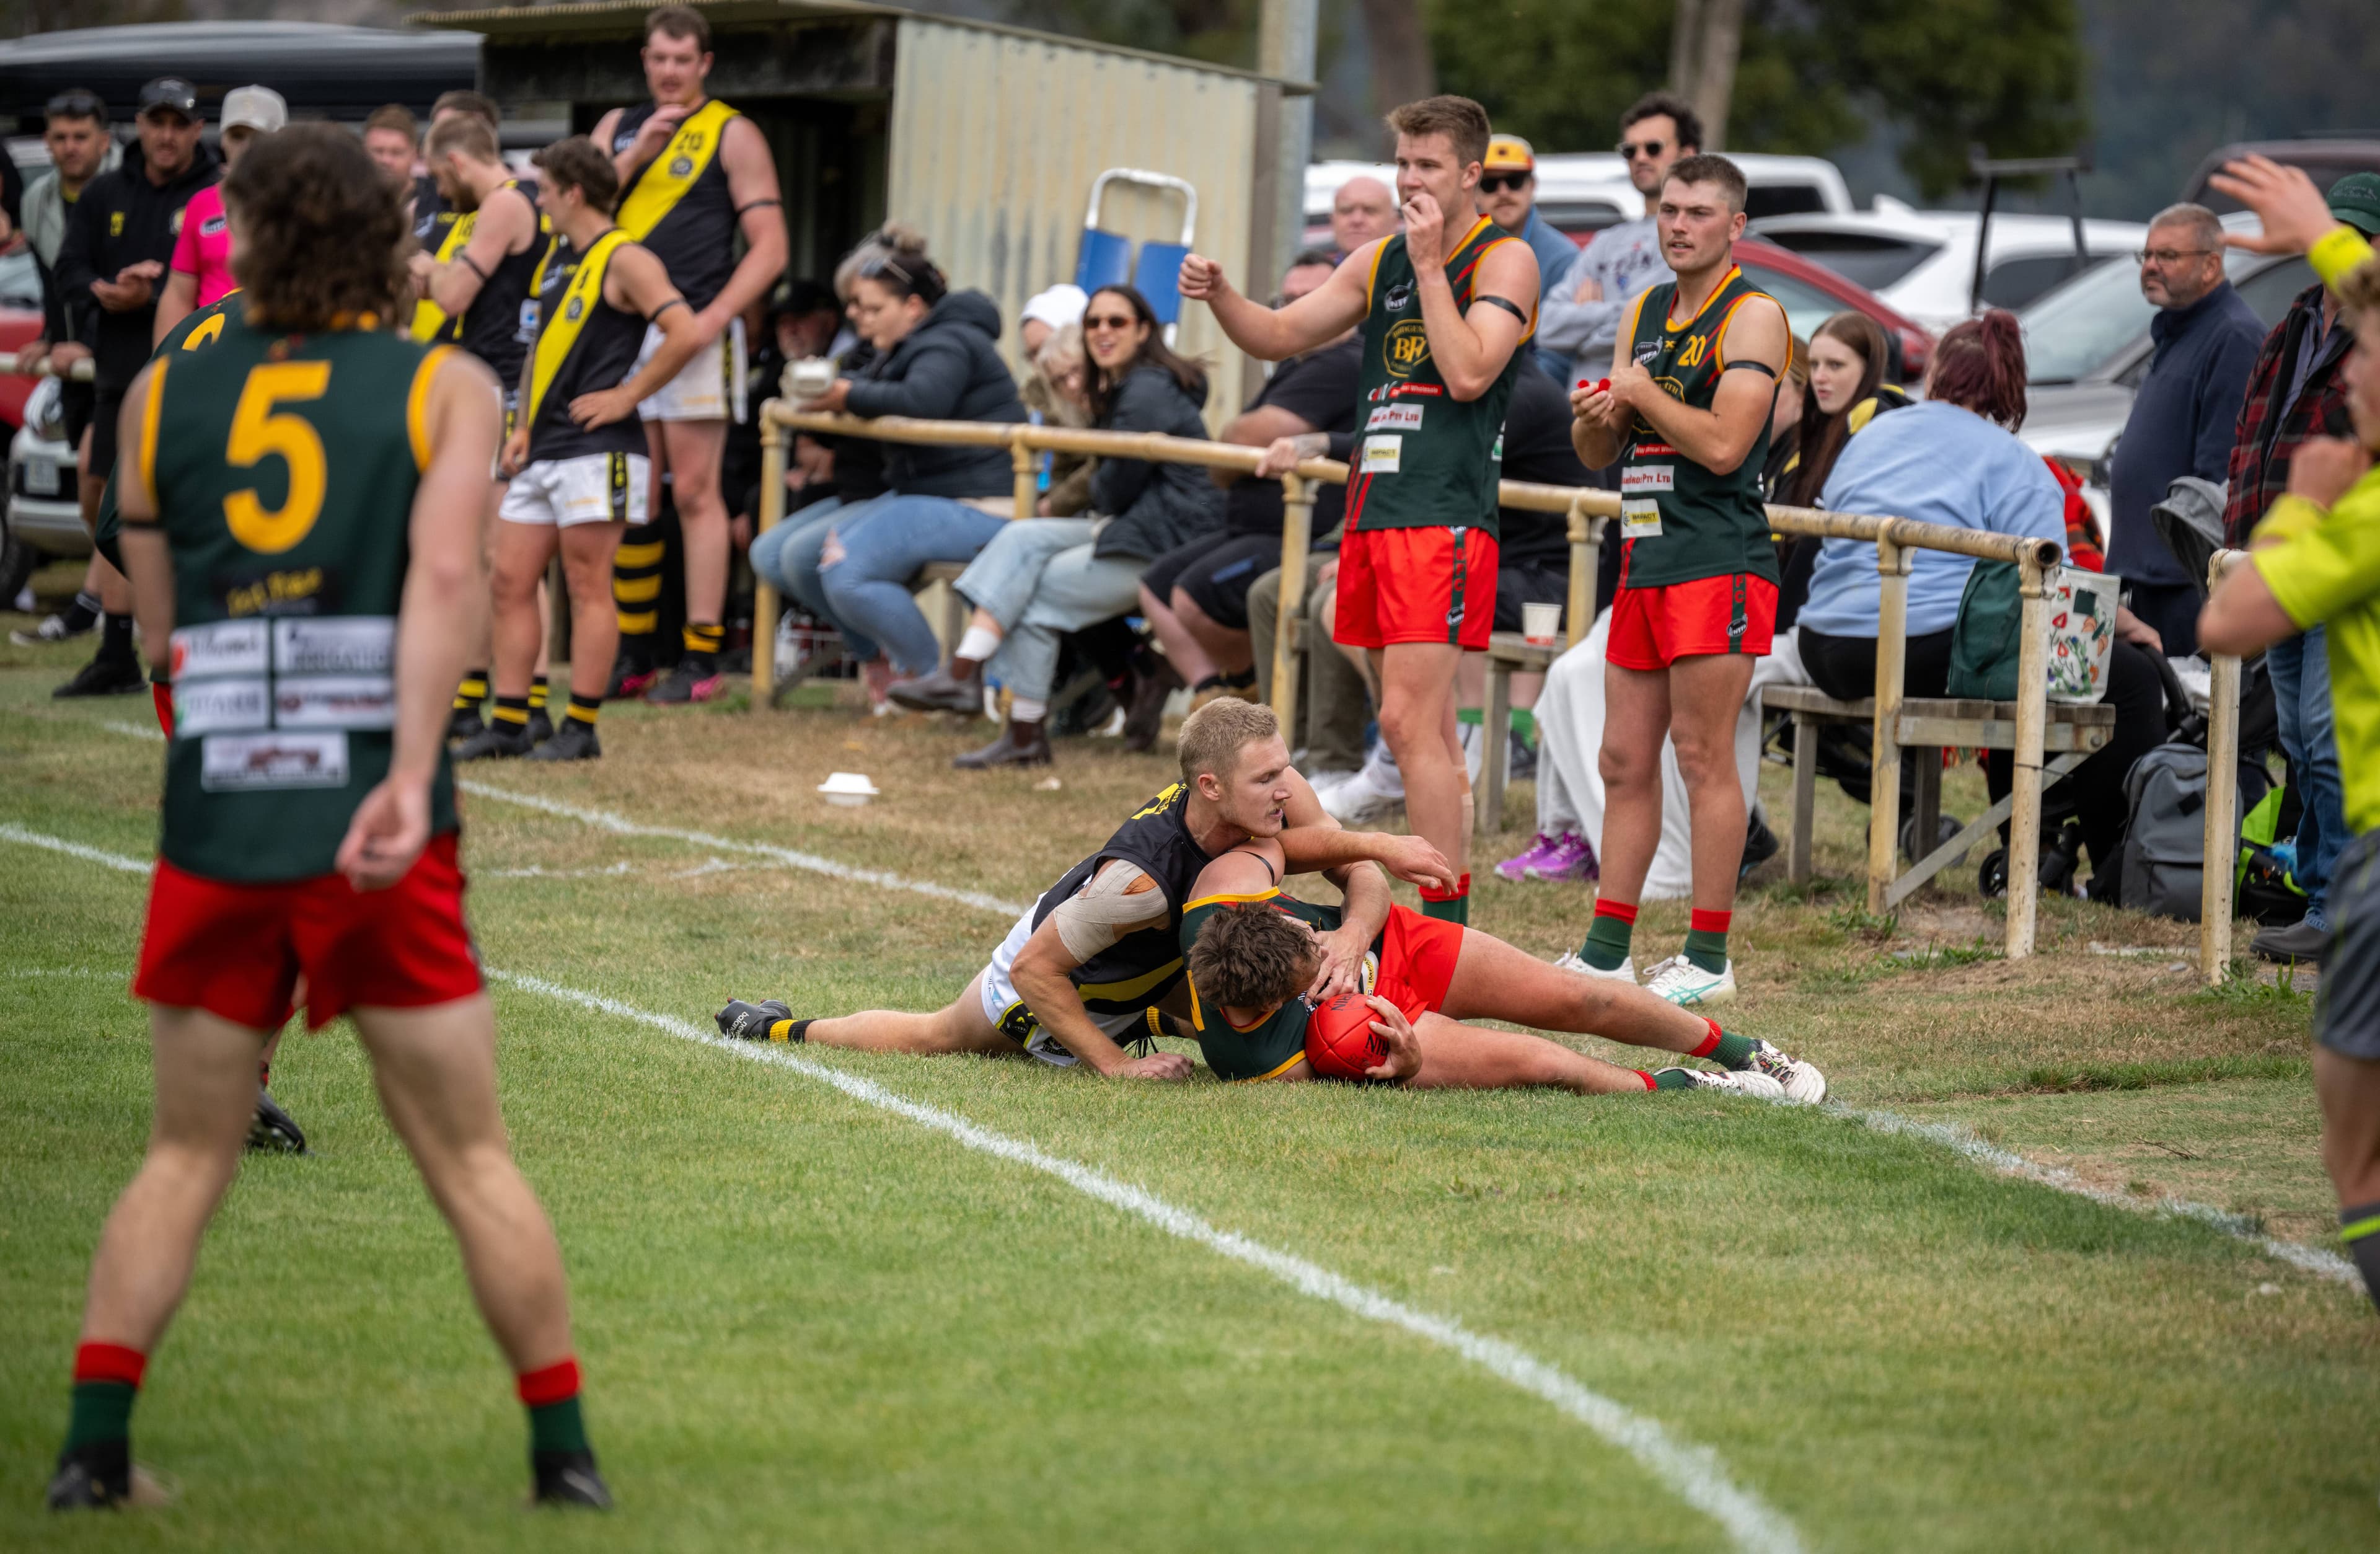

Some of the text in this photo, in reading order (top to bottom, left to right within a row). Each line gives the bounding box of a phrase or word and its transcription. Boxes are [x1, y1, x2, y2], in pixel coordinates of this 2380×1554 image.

[1677, 335, 1706, 367] 20
[224, 360, 332, 555] 5
[1642, 474, 1654, 483] PTY
[1657, 473, 1671, 483] LTD
